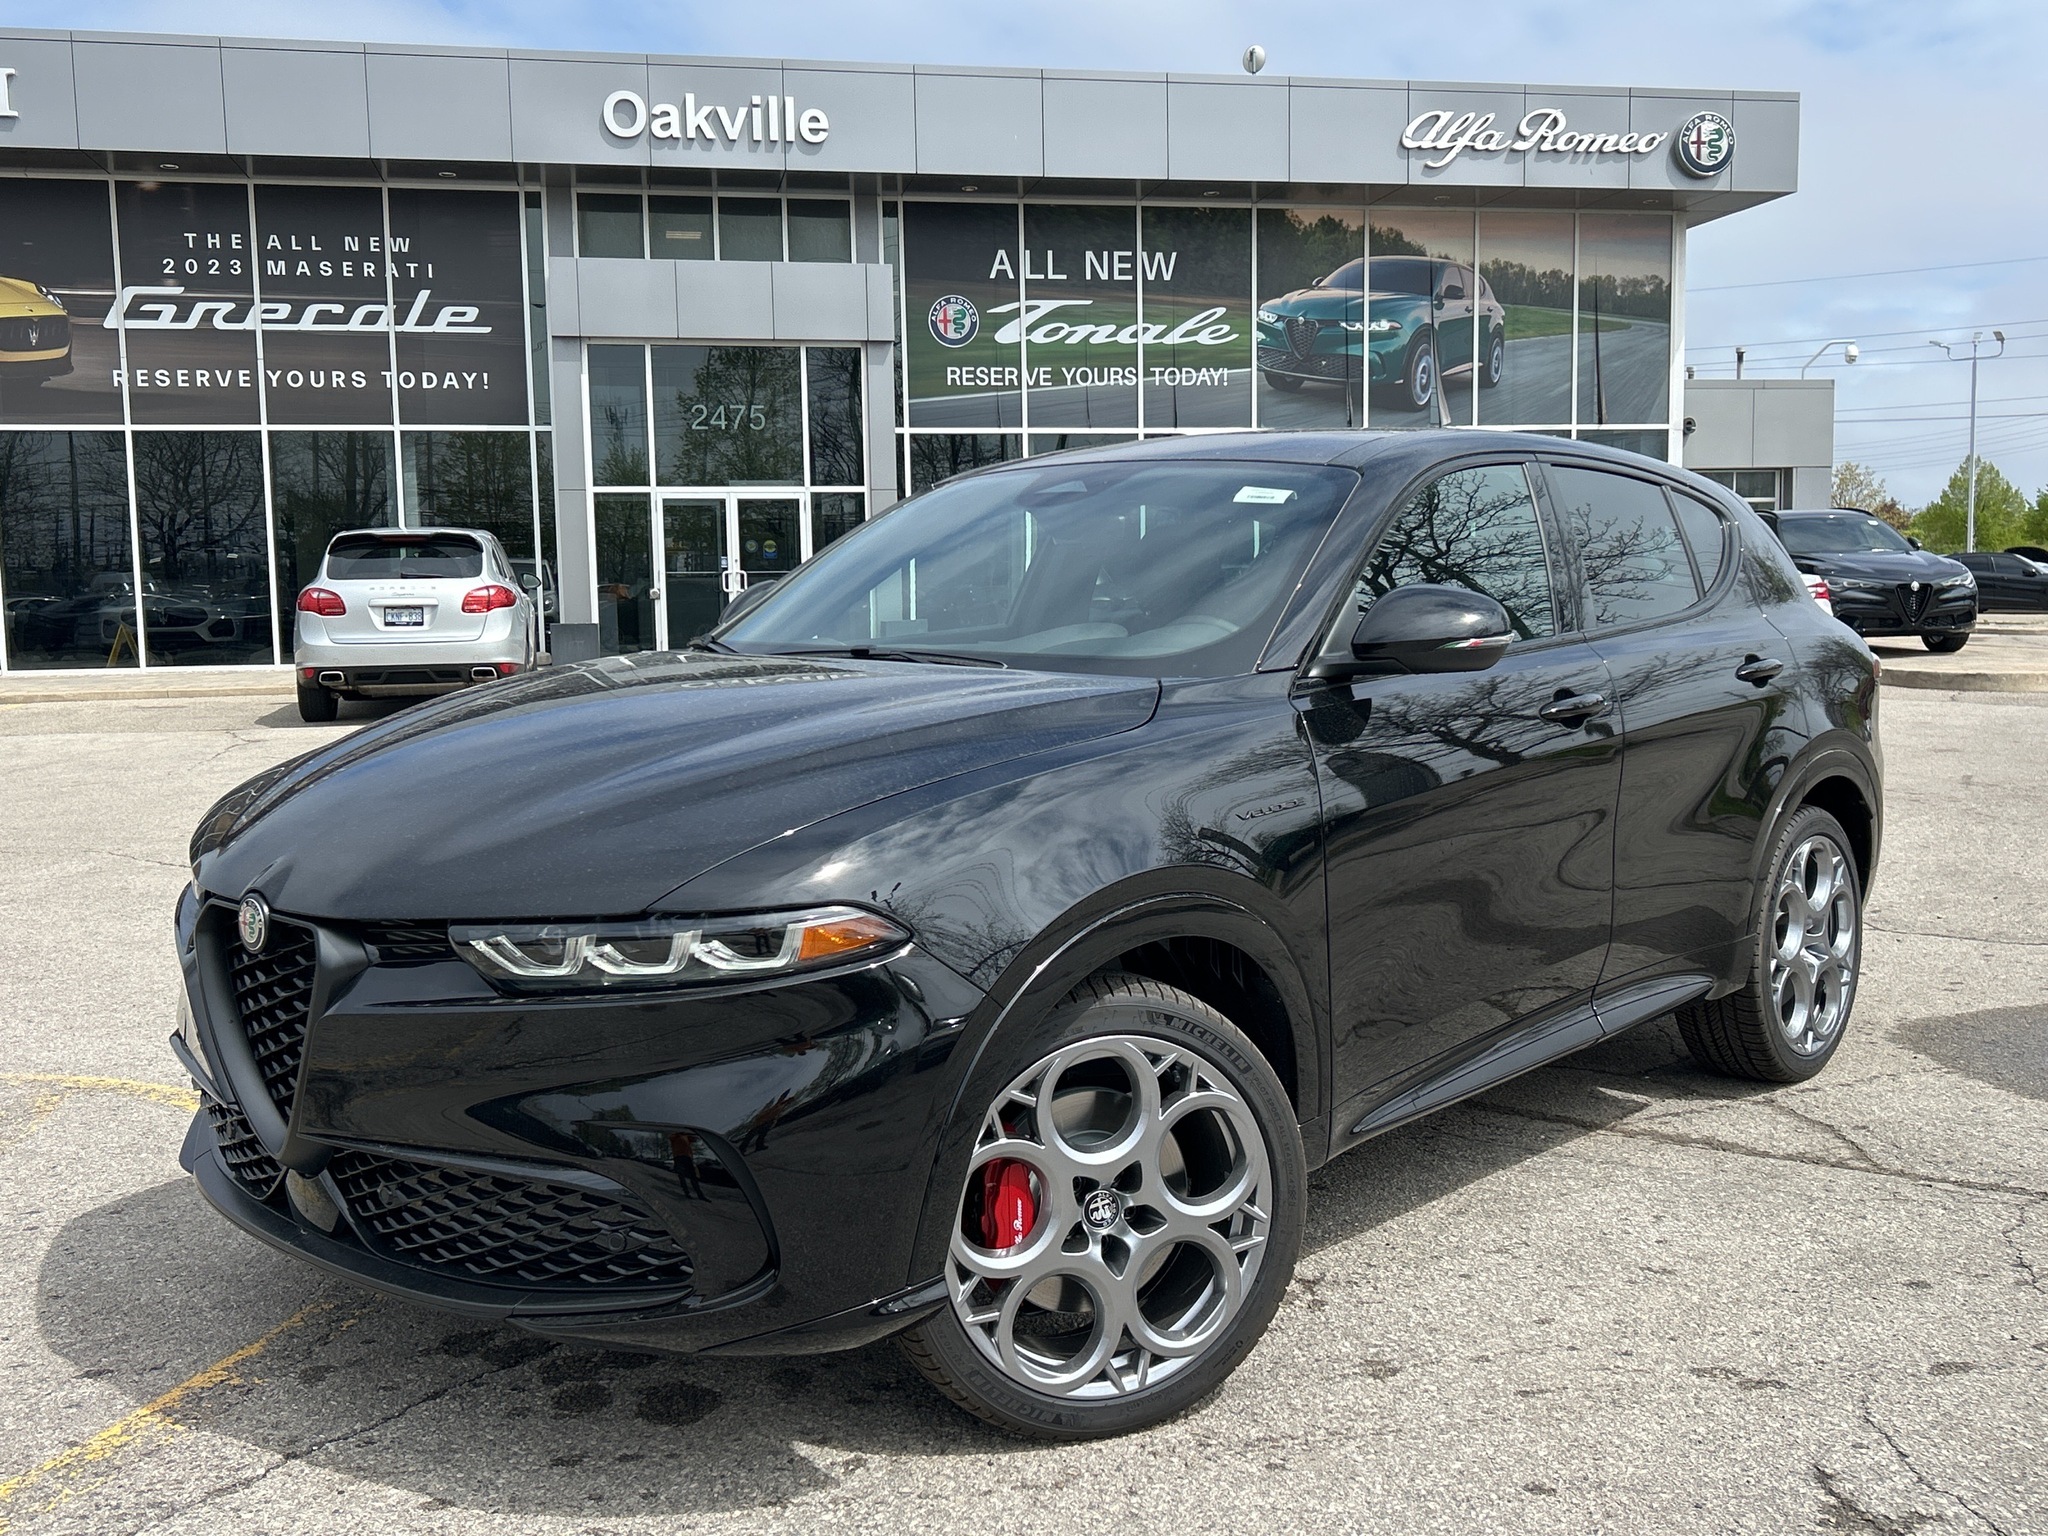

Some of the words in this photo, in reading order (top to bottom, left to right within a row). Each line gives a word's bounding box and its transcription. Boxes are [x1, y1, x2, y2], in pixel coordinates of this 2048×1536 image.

[602, 90, 830, 143] Oakville
[1682, 117, 1702, 143] ALFA
[1704, 114, 1734, 145] ROMEO
[1400, 108, 1512, 168] Alfa
[1510, 107, 1668, 153] Romeo
[184, 232, 243, 250] THE
[265, 234, 323, 252] ALL
[344, 235, 411, 253] NEW
[162, 257, 242, 275] 2023
[266, 259, 434, 279] MASERATI
[989, 249, 1067, 280] ALL
[1084, 250, 1178, 281] NEW
[103, 286, 493, 334] Grecale
[931, 301, 947, 322] ALFA
[950, 297, 977, 322] ROMEO
[986, 299, 1240, 345] Tonale
[112, 369, 252, 388] RESERVE
[265, 369, 368, 388] YOURS
[380, 371, 490, 390] TODAY!
[946, 366, 1053, 386] RESERVE
[1061, 366, 1138, 387] YOURS
[1150, 367, 1229, 387] TODAY!
[691, 404, 767, 431] 2475
[1171, 1017, 1249, 1072] MICHELIN
[970, 1369, 1057, 1425] MICHELIN
